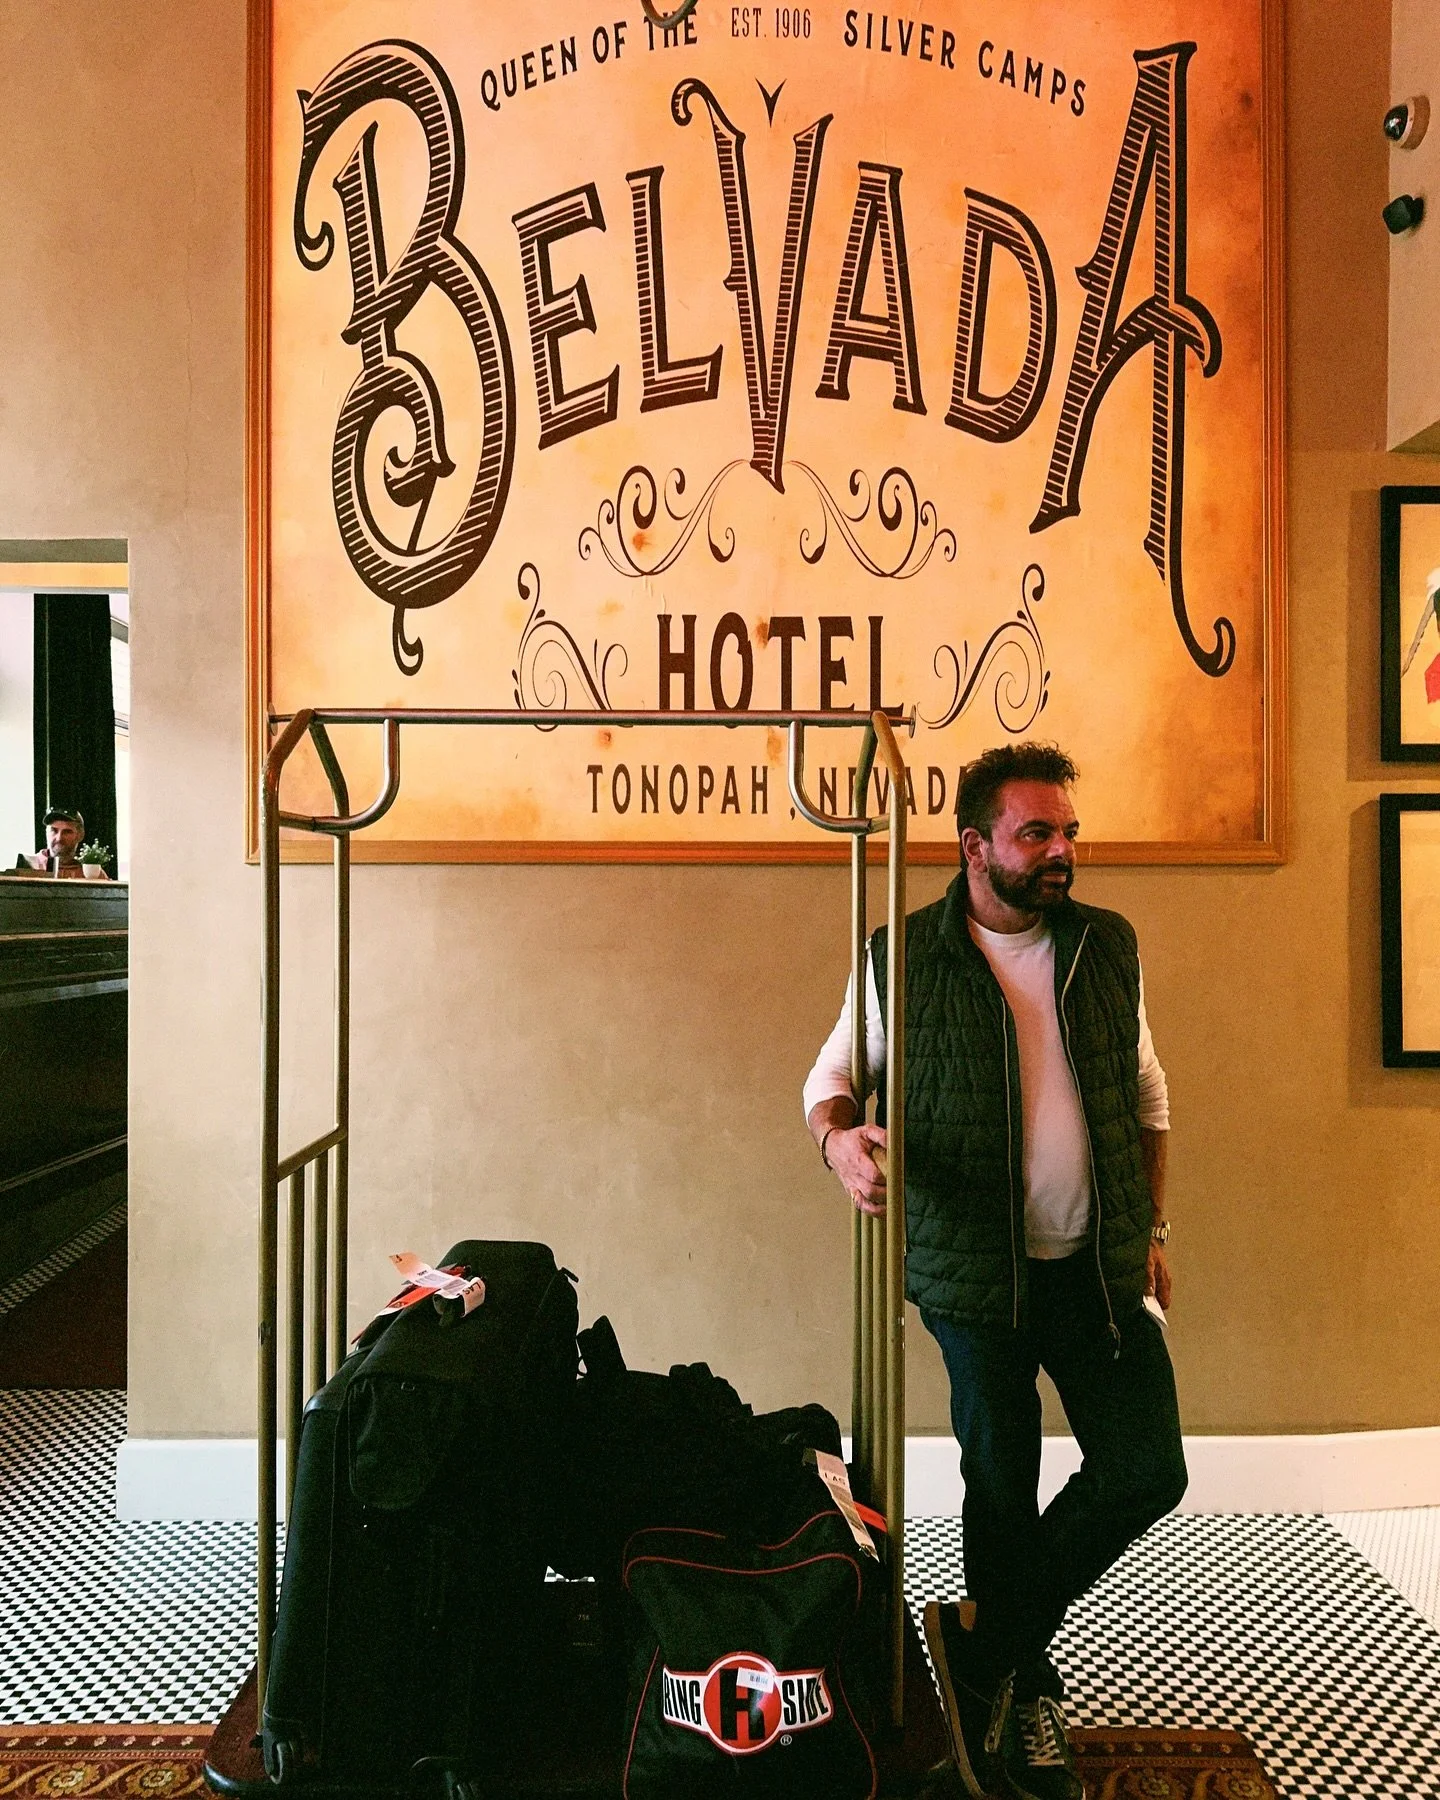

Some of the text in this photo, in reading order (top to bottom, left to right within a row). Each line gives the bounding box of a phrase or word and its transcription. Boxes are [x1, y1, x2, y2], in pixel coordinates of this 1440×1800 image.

[480, 8, 698, 112] QUEEN OF THE
[731, 7, 811, 38] EST. 1906
[844, 9, 1086, 117] SILVER CAMPS
[295, 41, 1234, 676] BELVADA
[657, 612, 904, 728] HOTEL
[663, 1671, 702, 1726] RING
